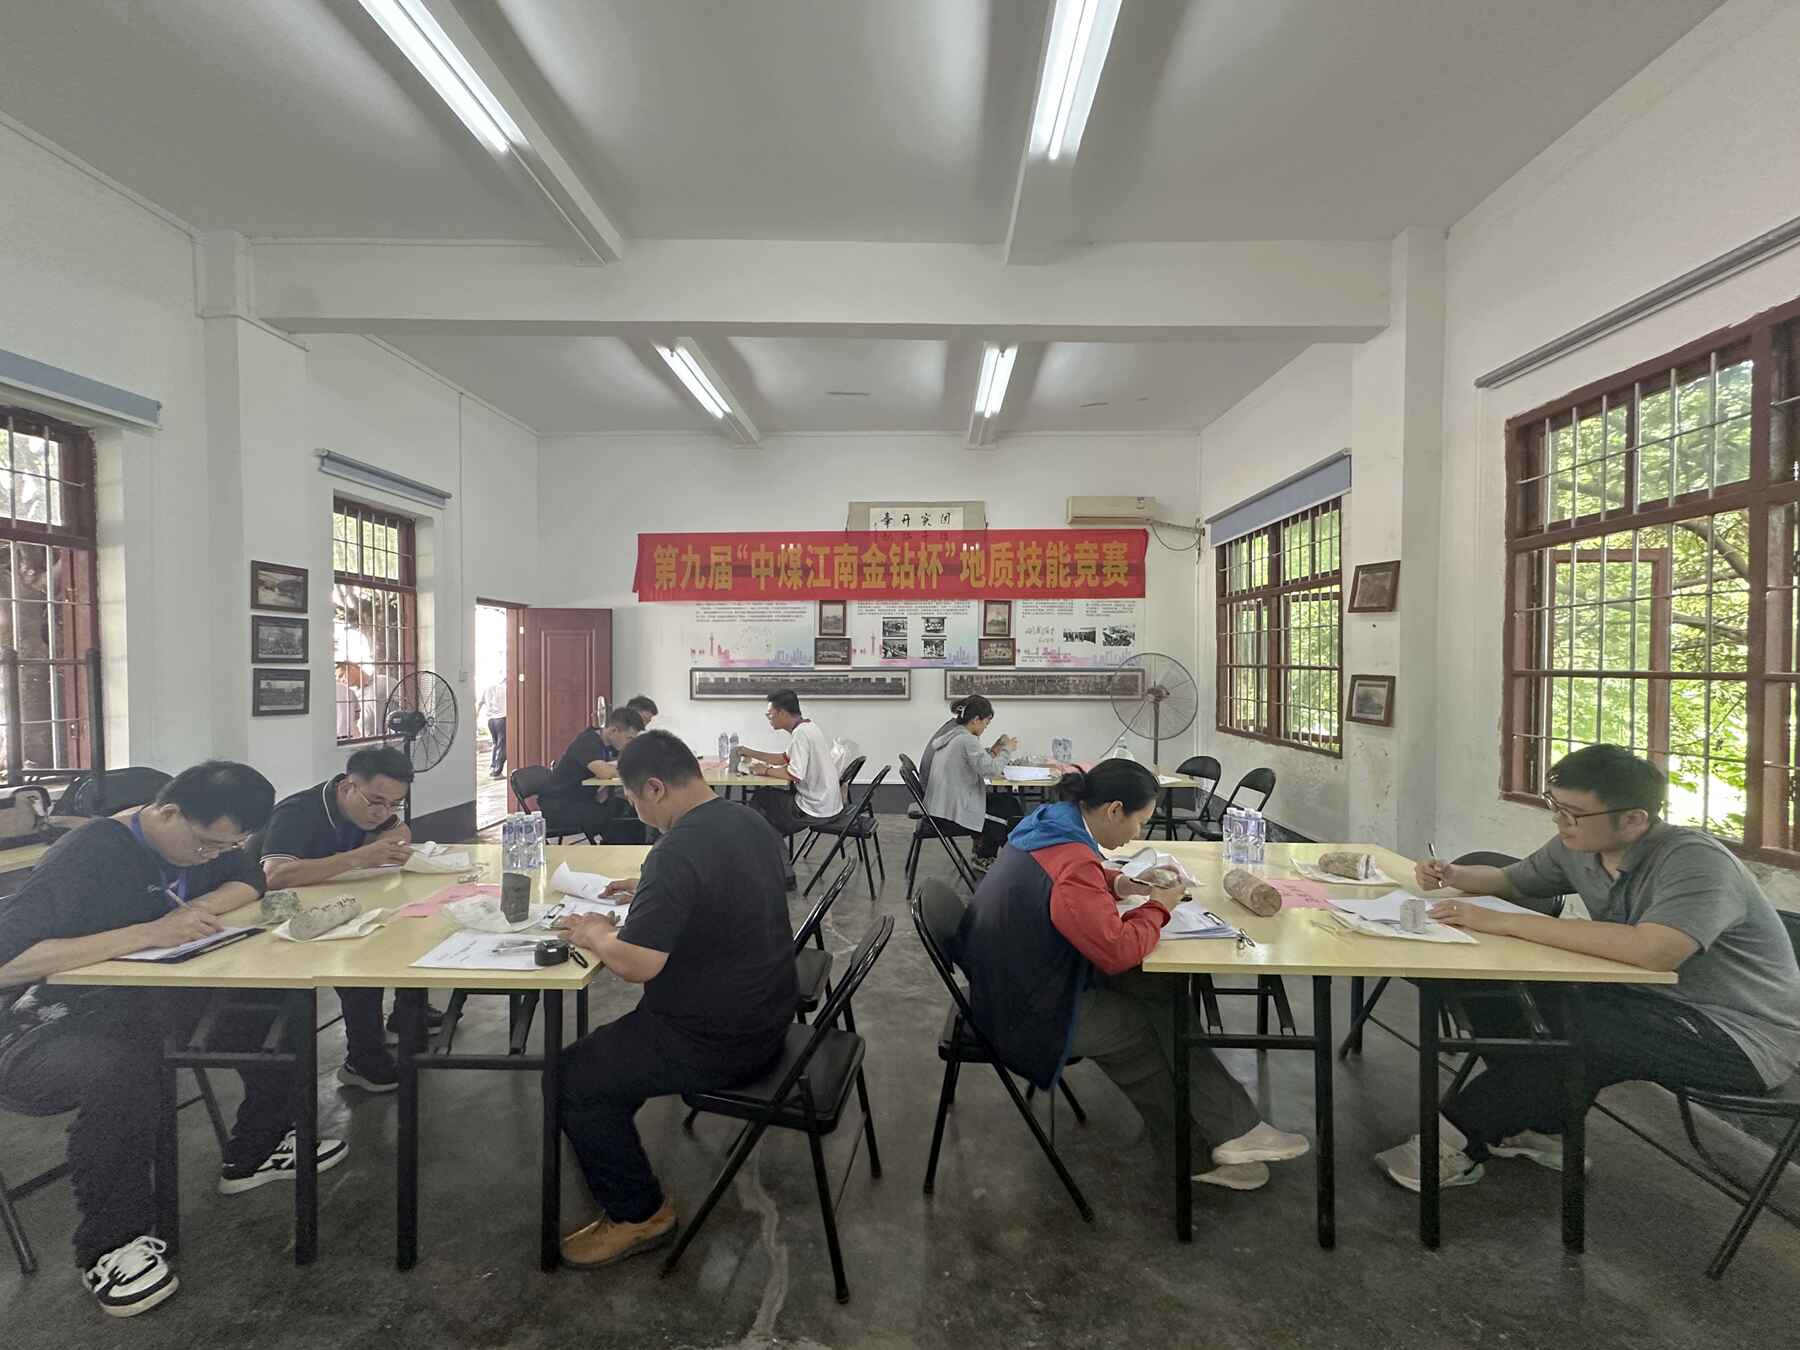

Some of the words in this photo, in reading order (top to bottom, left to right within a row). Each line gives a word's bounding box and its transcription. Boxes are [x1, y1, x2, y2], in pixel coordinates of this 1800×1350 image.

[654, 542, 1129, 590] 第九届“中煤江南金钻杯”地质技能竞赛
